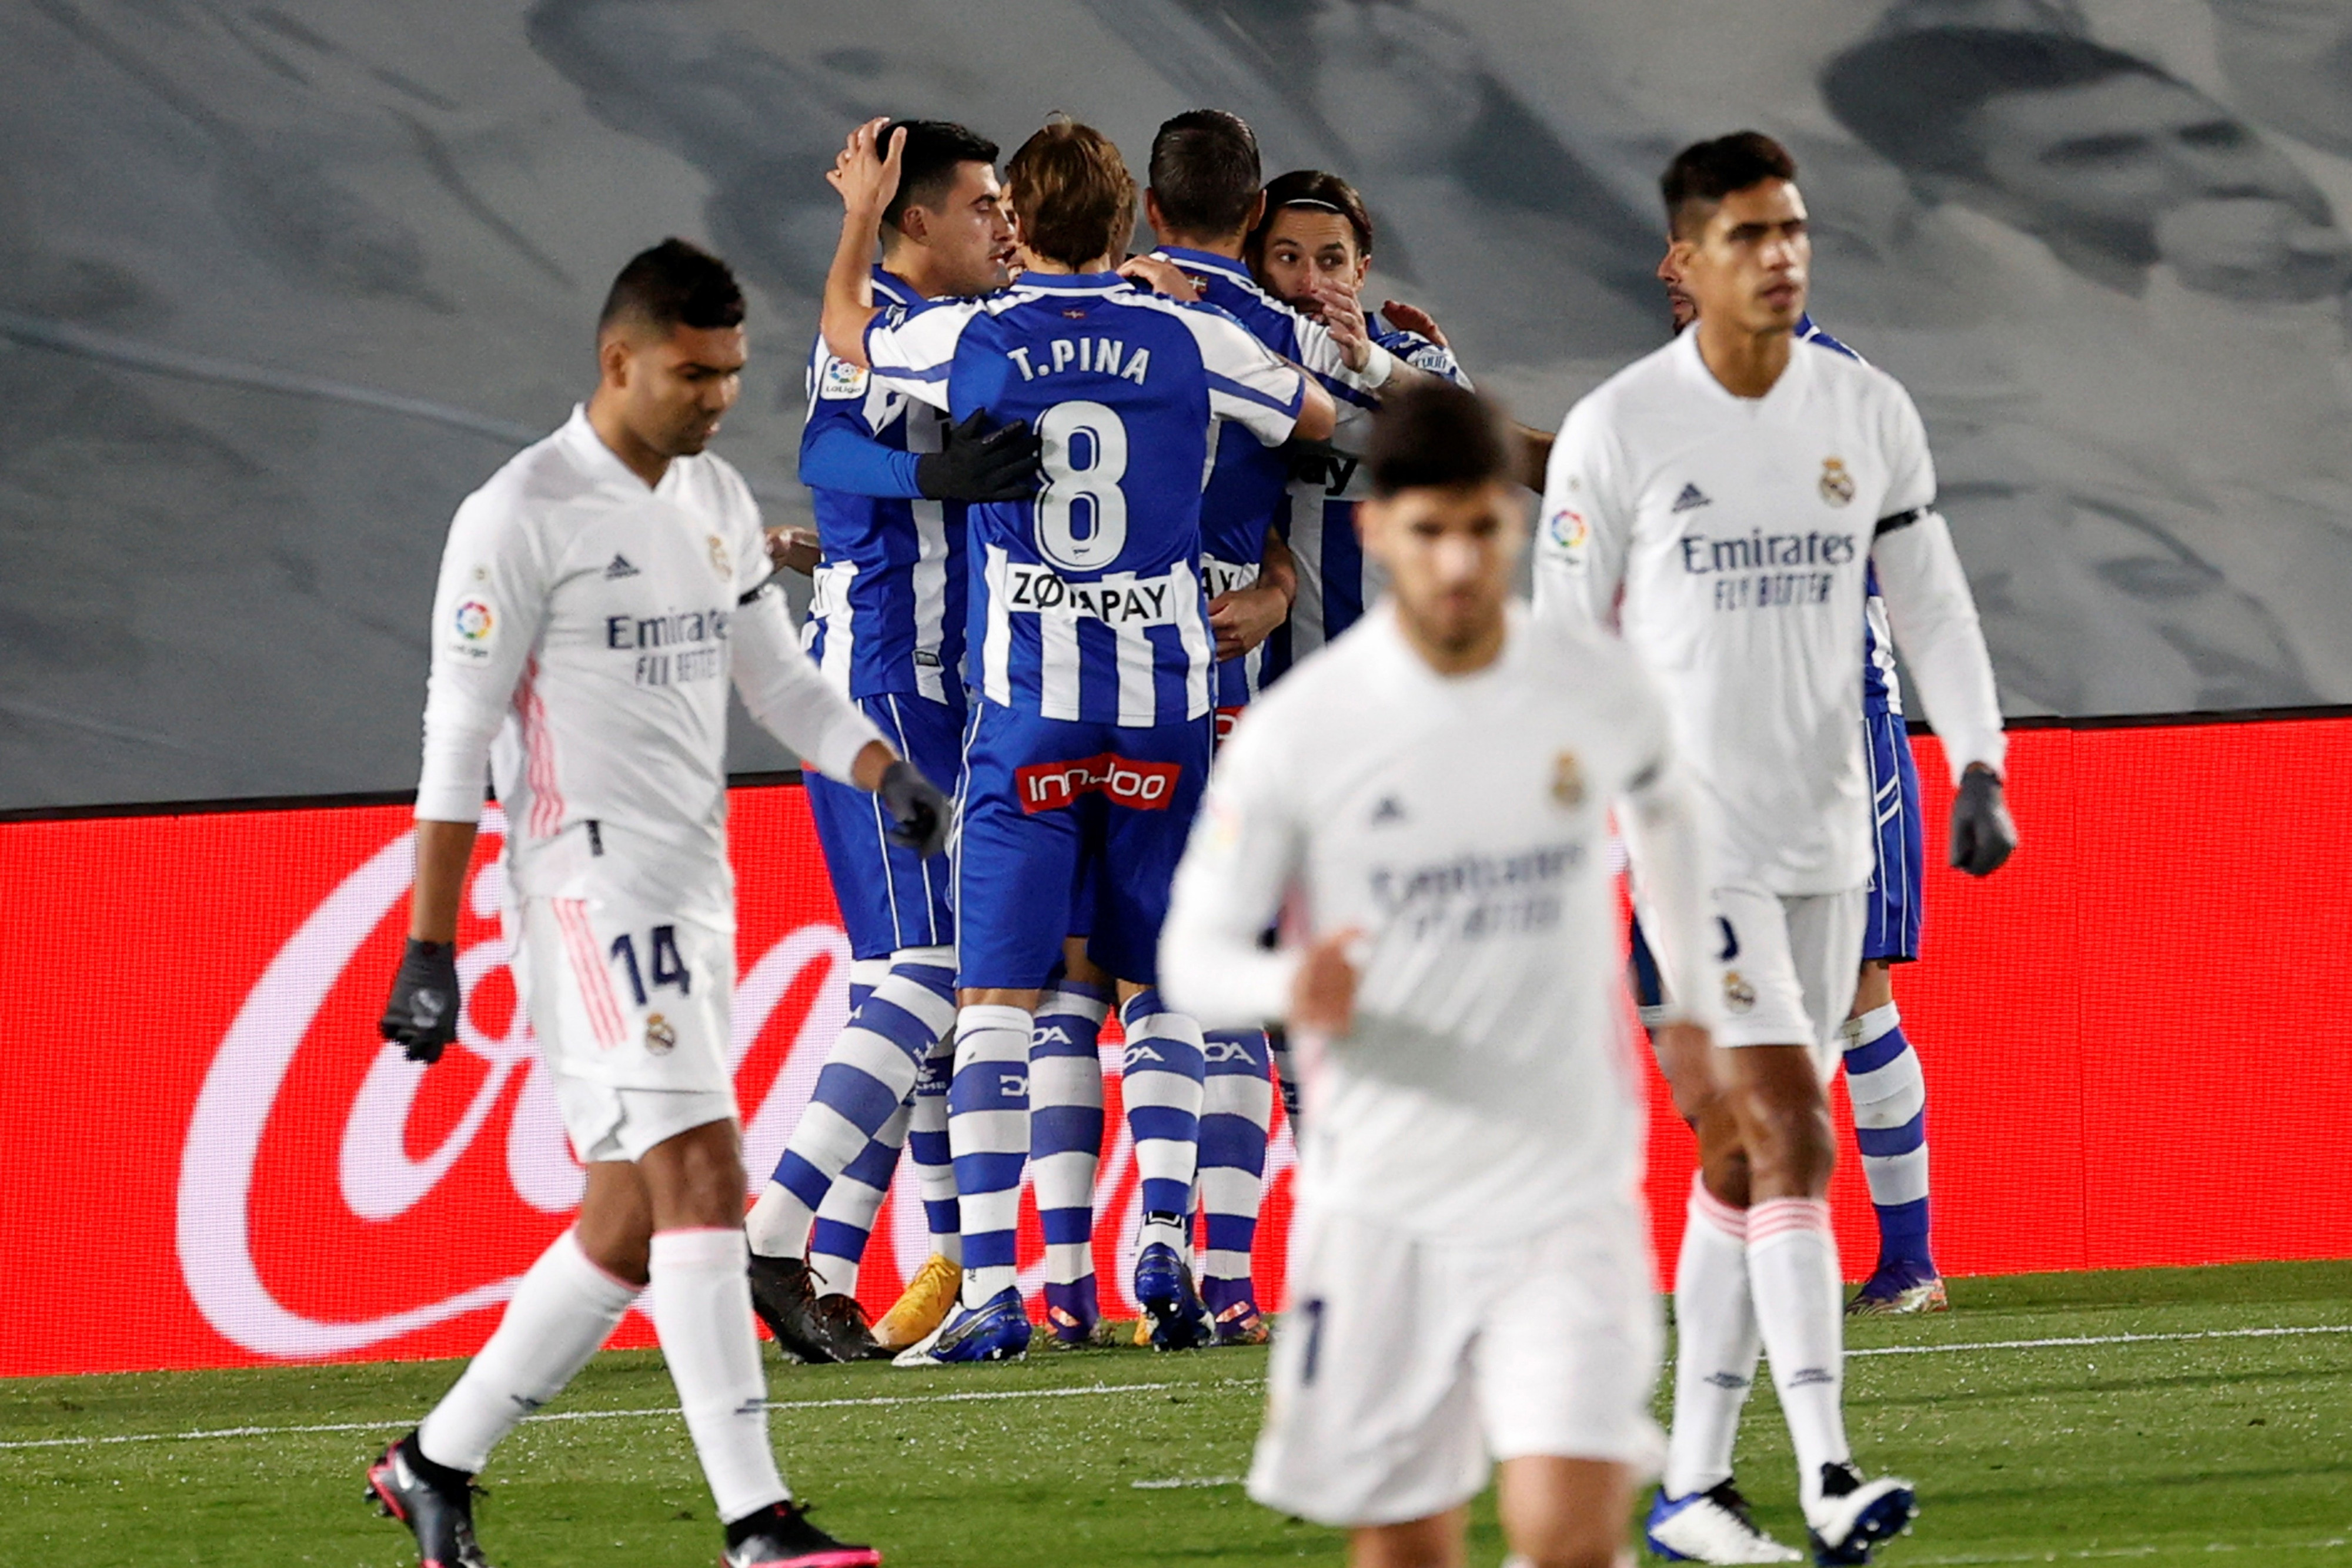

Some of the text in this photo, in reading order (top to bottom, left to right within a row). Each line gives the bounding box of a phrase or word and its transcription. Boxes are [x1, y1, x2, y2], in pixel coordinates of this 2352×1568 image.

[1006, 337, 1151, 386] T.PINA
[1034, 400, 1128, 572] 8
[1680, 527, 1855, 574] Emirates
[610, 925, 690, 1006] 14
